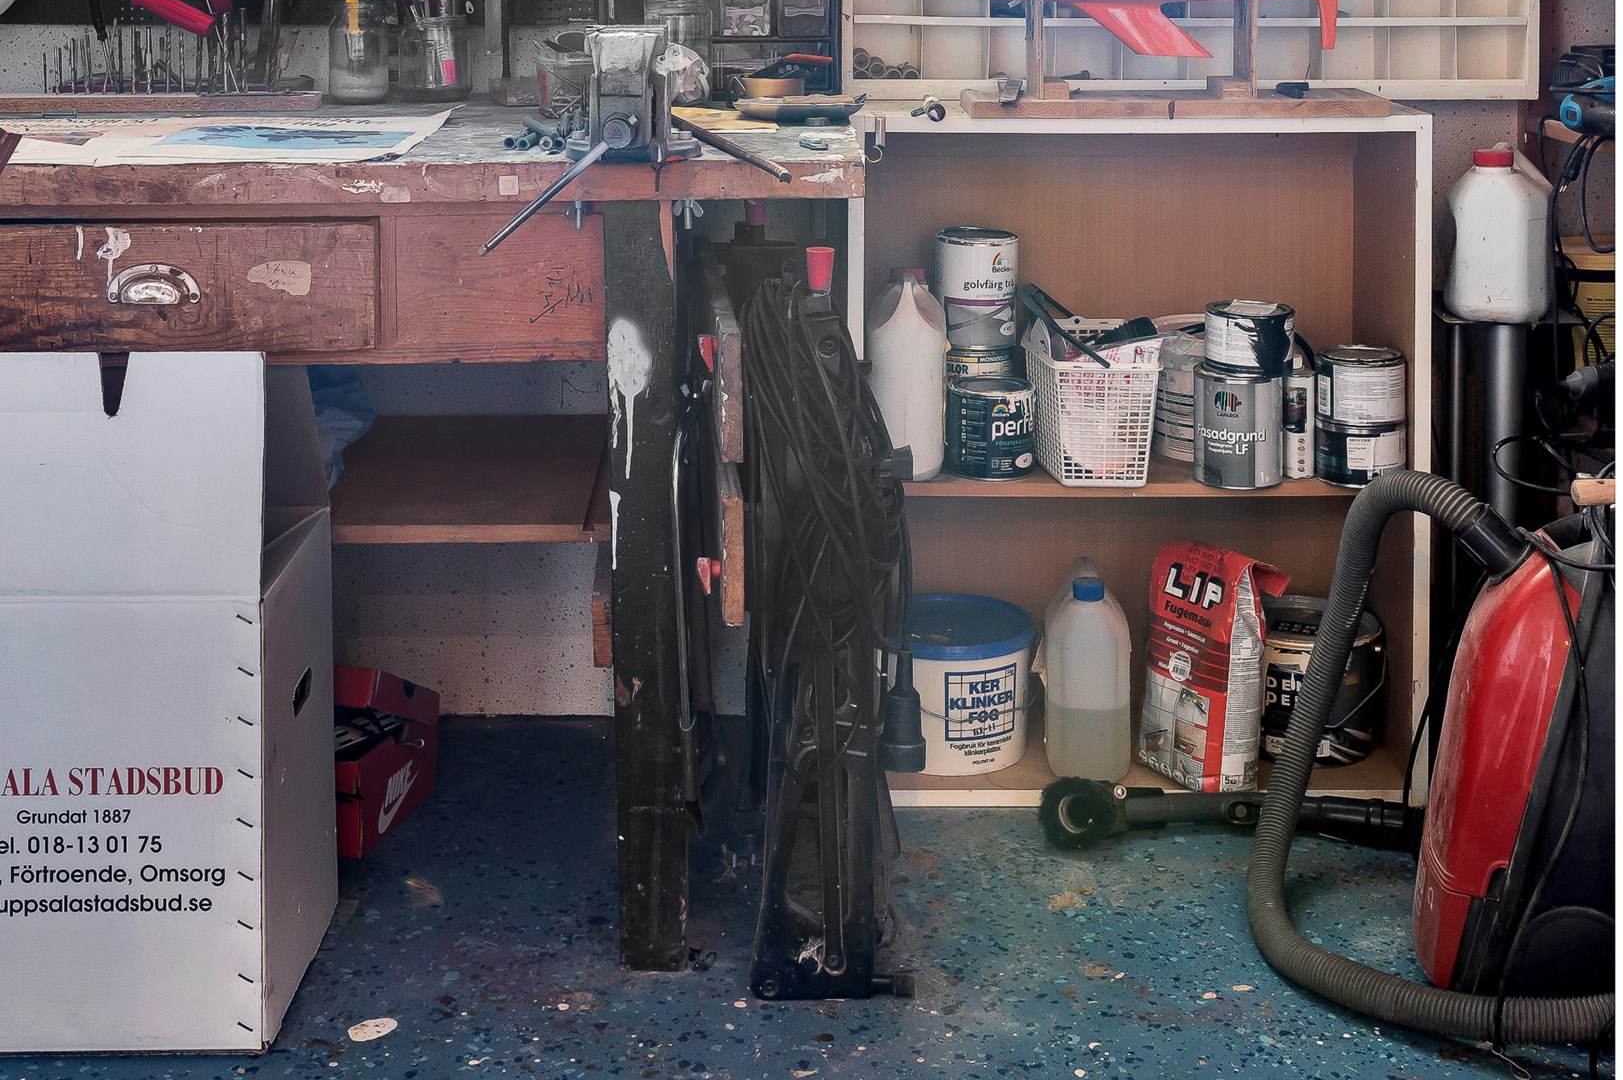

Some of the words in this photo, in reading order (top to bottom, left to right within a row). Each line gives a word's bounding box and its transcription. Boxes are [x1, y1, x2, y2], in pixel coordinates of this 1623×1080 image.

[963, 279, 1003, 291] golvfärg
[1216, 411, 1240, 419] CAPAROL
[1235, 443, 1249, 455] LF
[1163, 561, 1226, 610] LIP
[969, 679, 1000, 695] KER
[950, 690, 1013, 710] KLINKER
[968, 708, 1000, 724] FOG
[68, 767, 224, 796] STADSBUD
[385, 760, 413, 808] NIKE
[16, 810, 88, 825] Grundat
[93, 809, 131, 824] 1887
[27, 836, 100, 854] 018-13
[106, 835, 128, 854] 01
[138, 835, 162, 854] 75
[10, 865, 133, 886] Förtroende,
[140, 864, 226, 887] Omsorg
[0, 894, 213, 917] uppsalastadsbud.se
